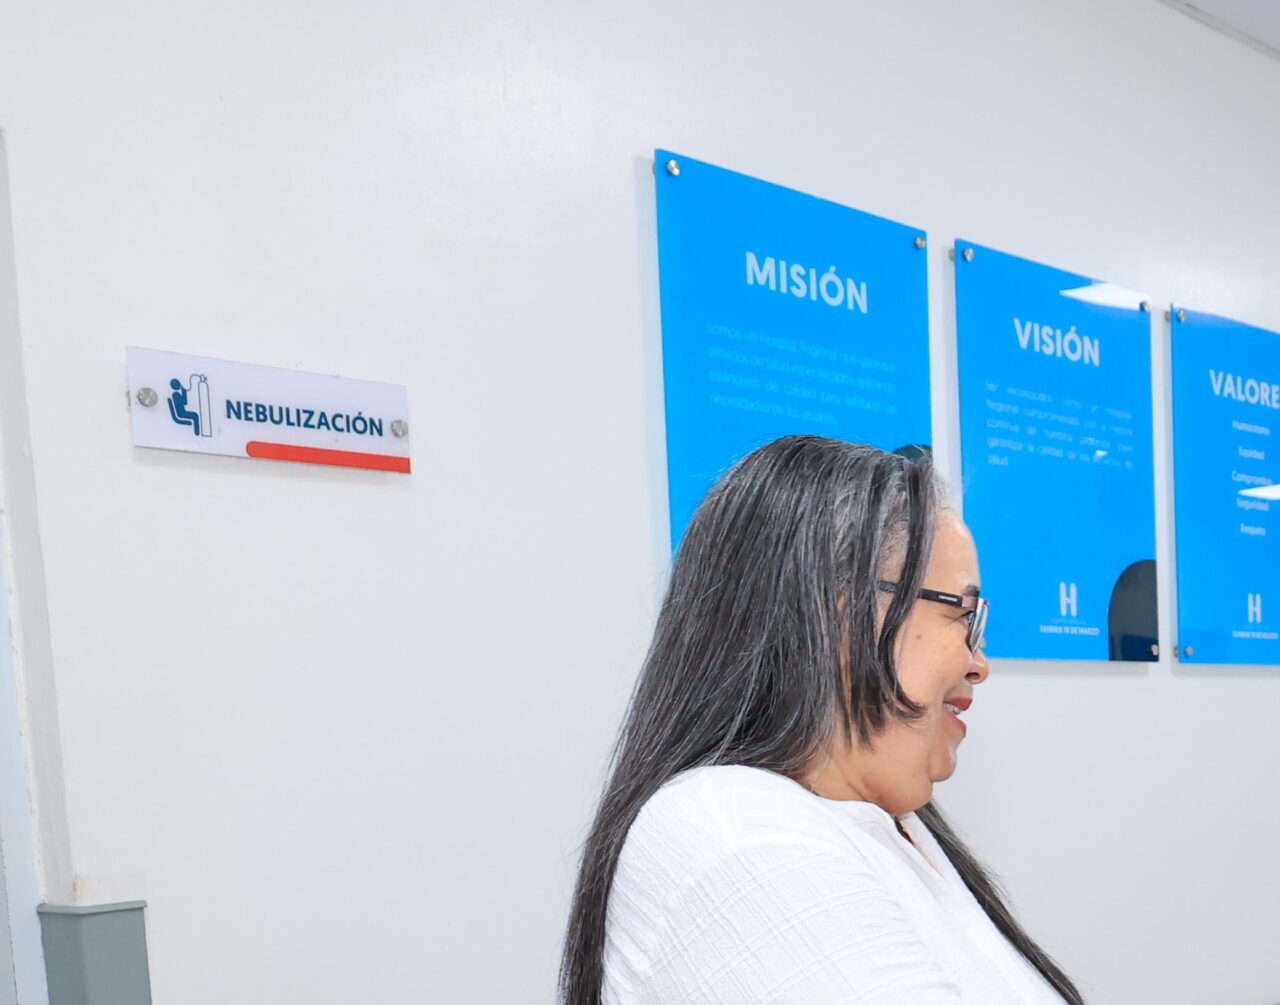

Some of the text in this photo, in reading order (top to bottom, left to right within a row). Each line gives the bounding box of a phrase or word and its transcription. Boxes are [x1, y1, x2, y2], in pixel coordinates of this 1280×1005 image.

[745, 251, 868, 314] MISIÓN
[1013, 317, 1100, 367] VISIÓN
[225, 399, 383, 437] NEBULIZACIÓN
